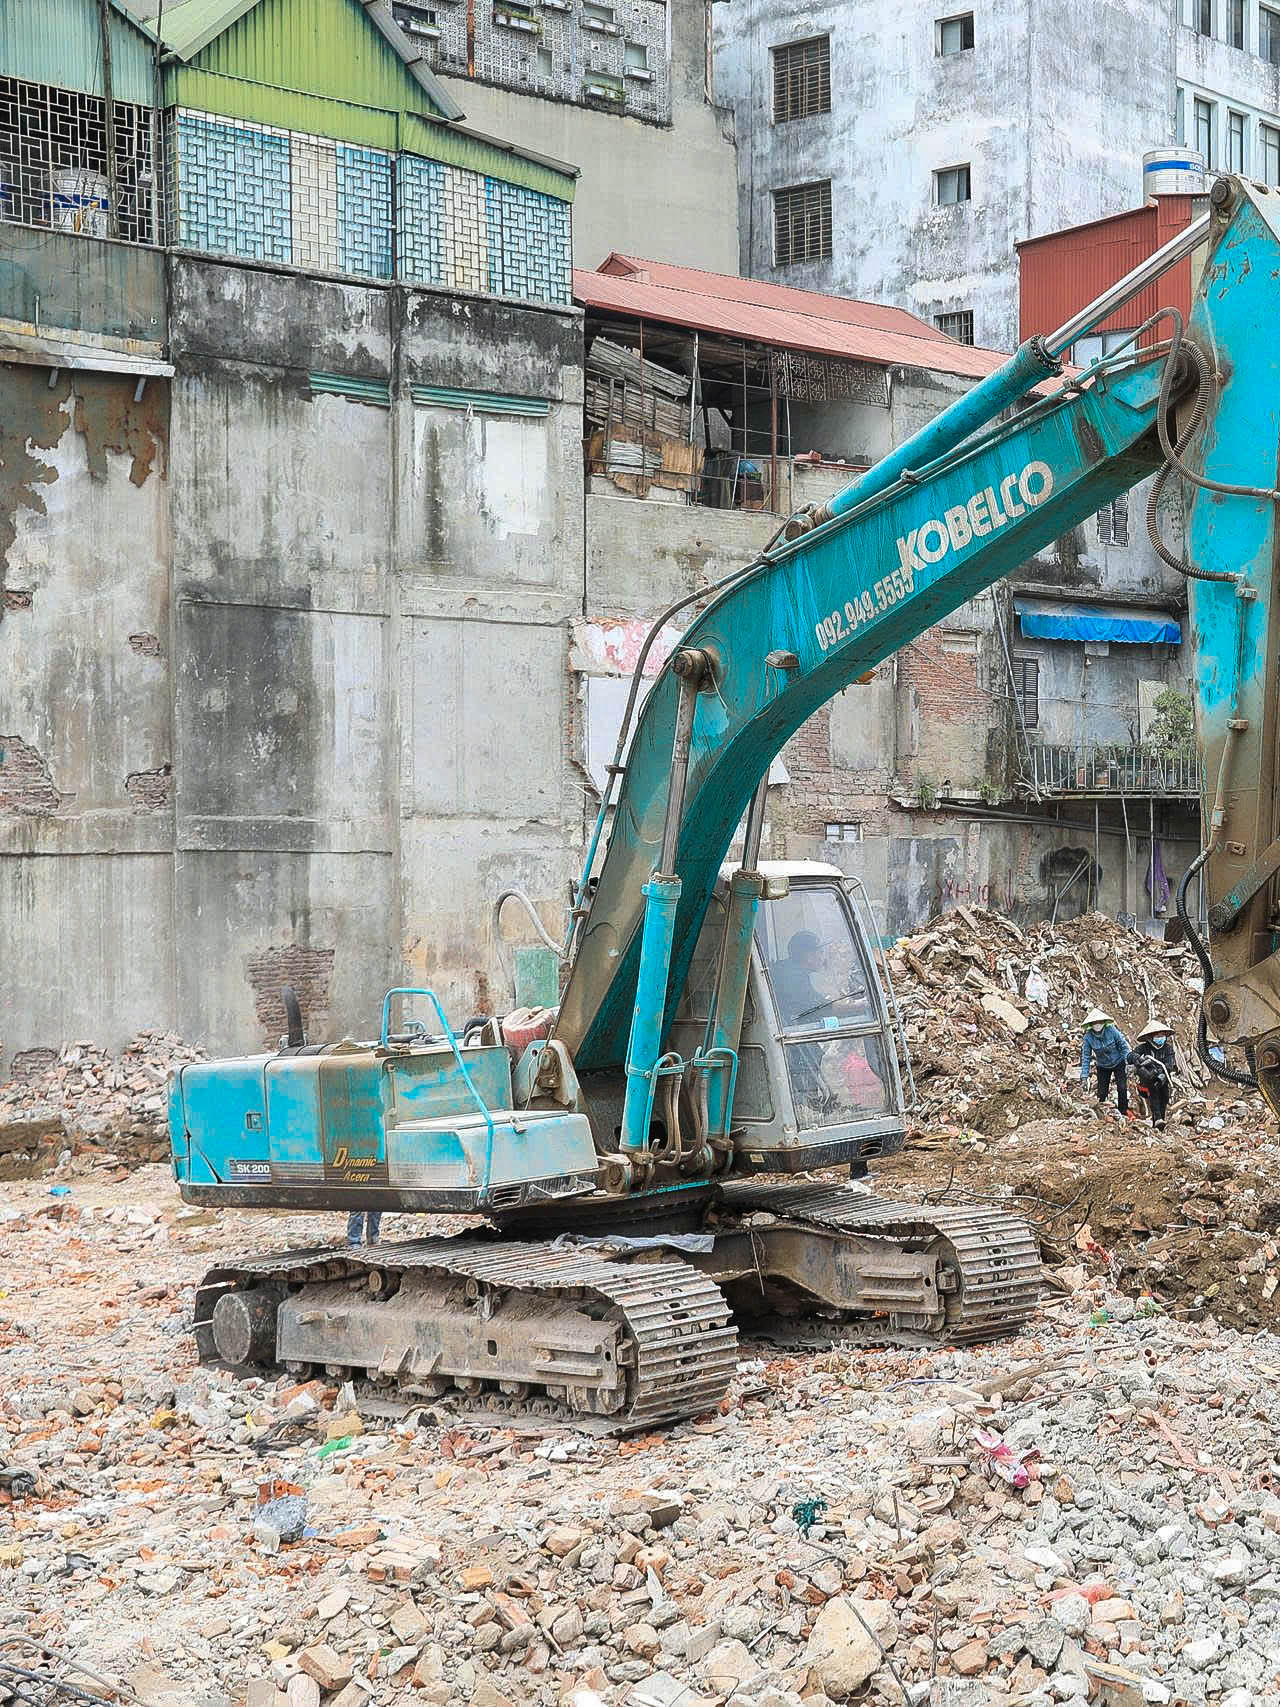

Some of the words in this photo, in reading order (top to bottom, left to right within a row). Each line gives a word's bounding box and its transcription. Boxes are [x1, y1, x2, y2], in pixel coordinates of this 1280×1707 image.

[896, 460, 1054, 576] KOBELCO
[333, 1147, 376, 1169] Dynamic
[343, 1170, 371, 1182] Acera
